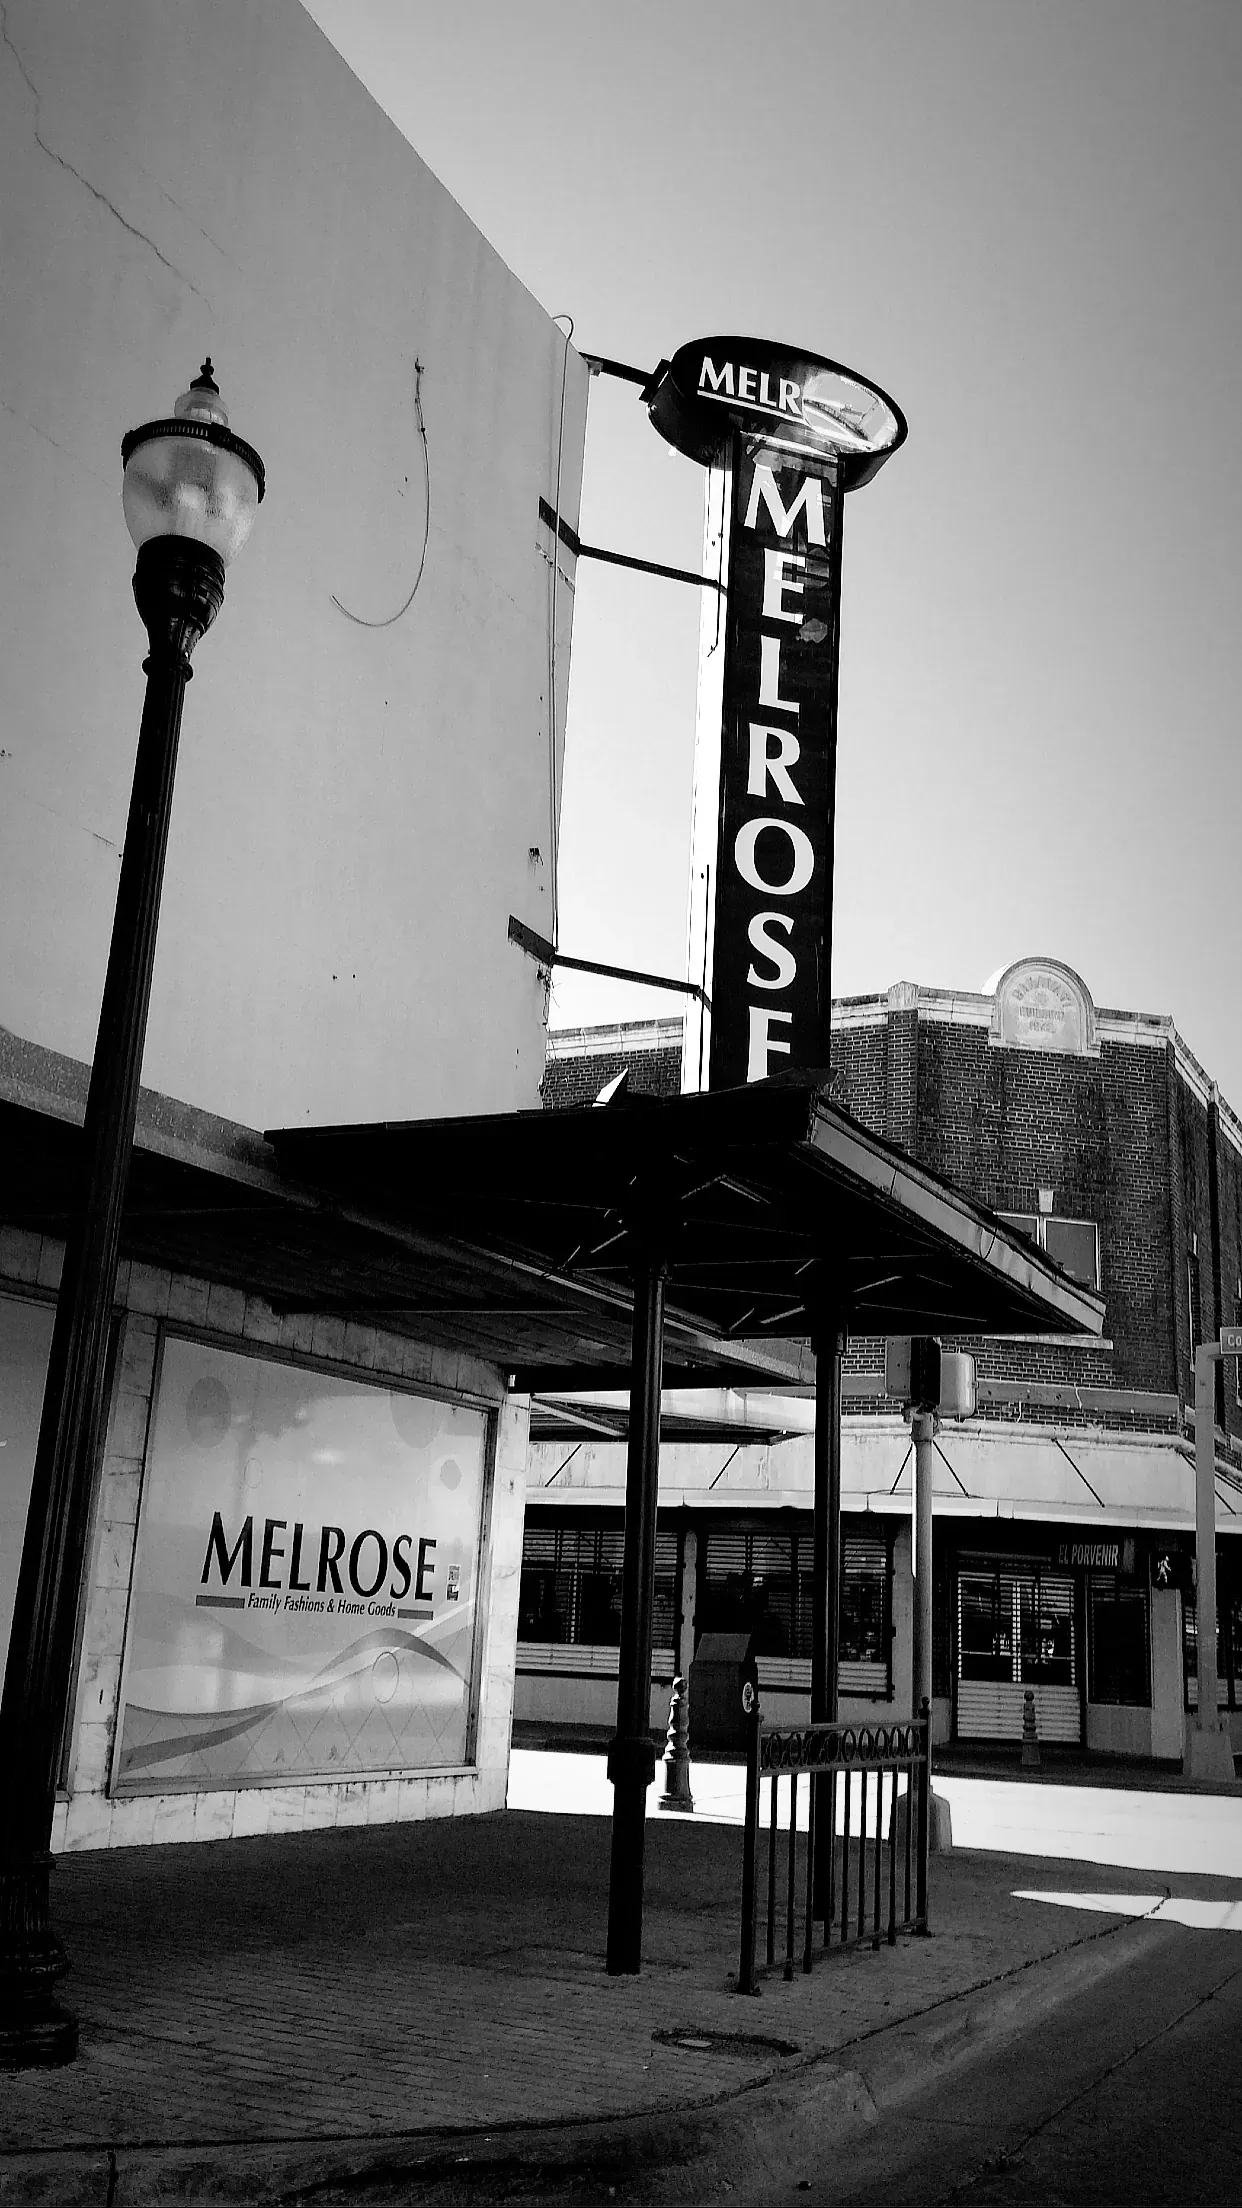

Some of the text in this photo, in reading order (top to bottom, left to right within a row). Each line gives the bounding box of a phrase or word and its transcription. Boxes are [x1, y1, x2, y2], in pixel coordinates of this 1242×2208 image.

[734, 463, 827, 1083] MELROSE
[200, 1511, 437, 1601] MELROSE
[1058, 1545, 1119, 1567] EL PORVENIR
[247, 1593, 396, 1617] Family Fashions & Home Goods
